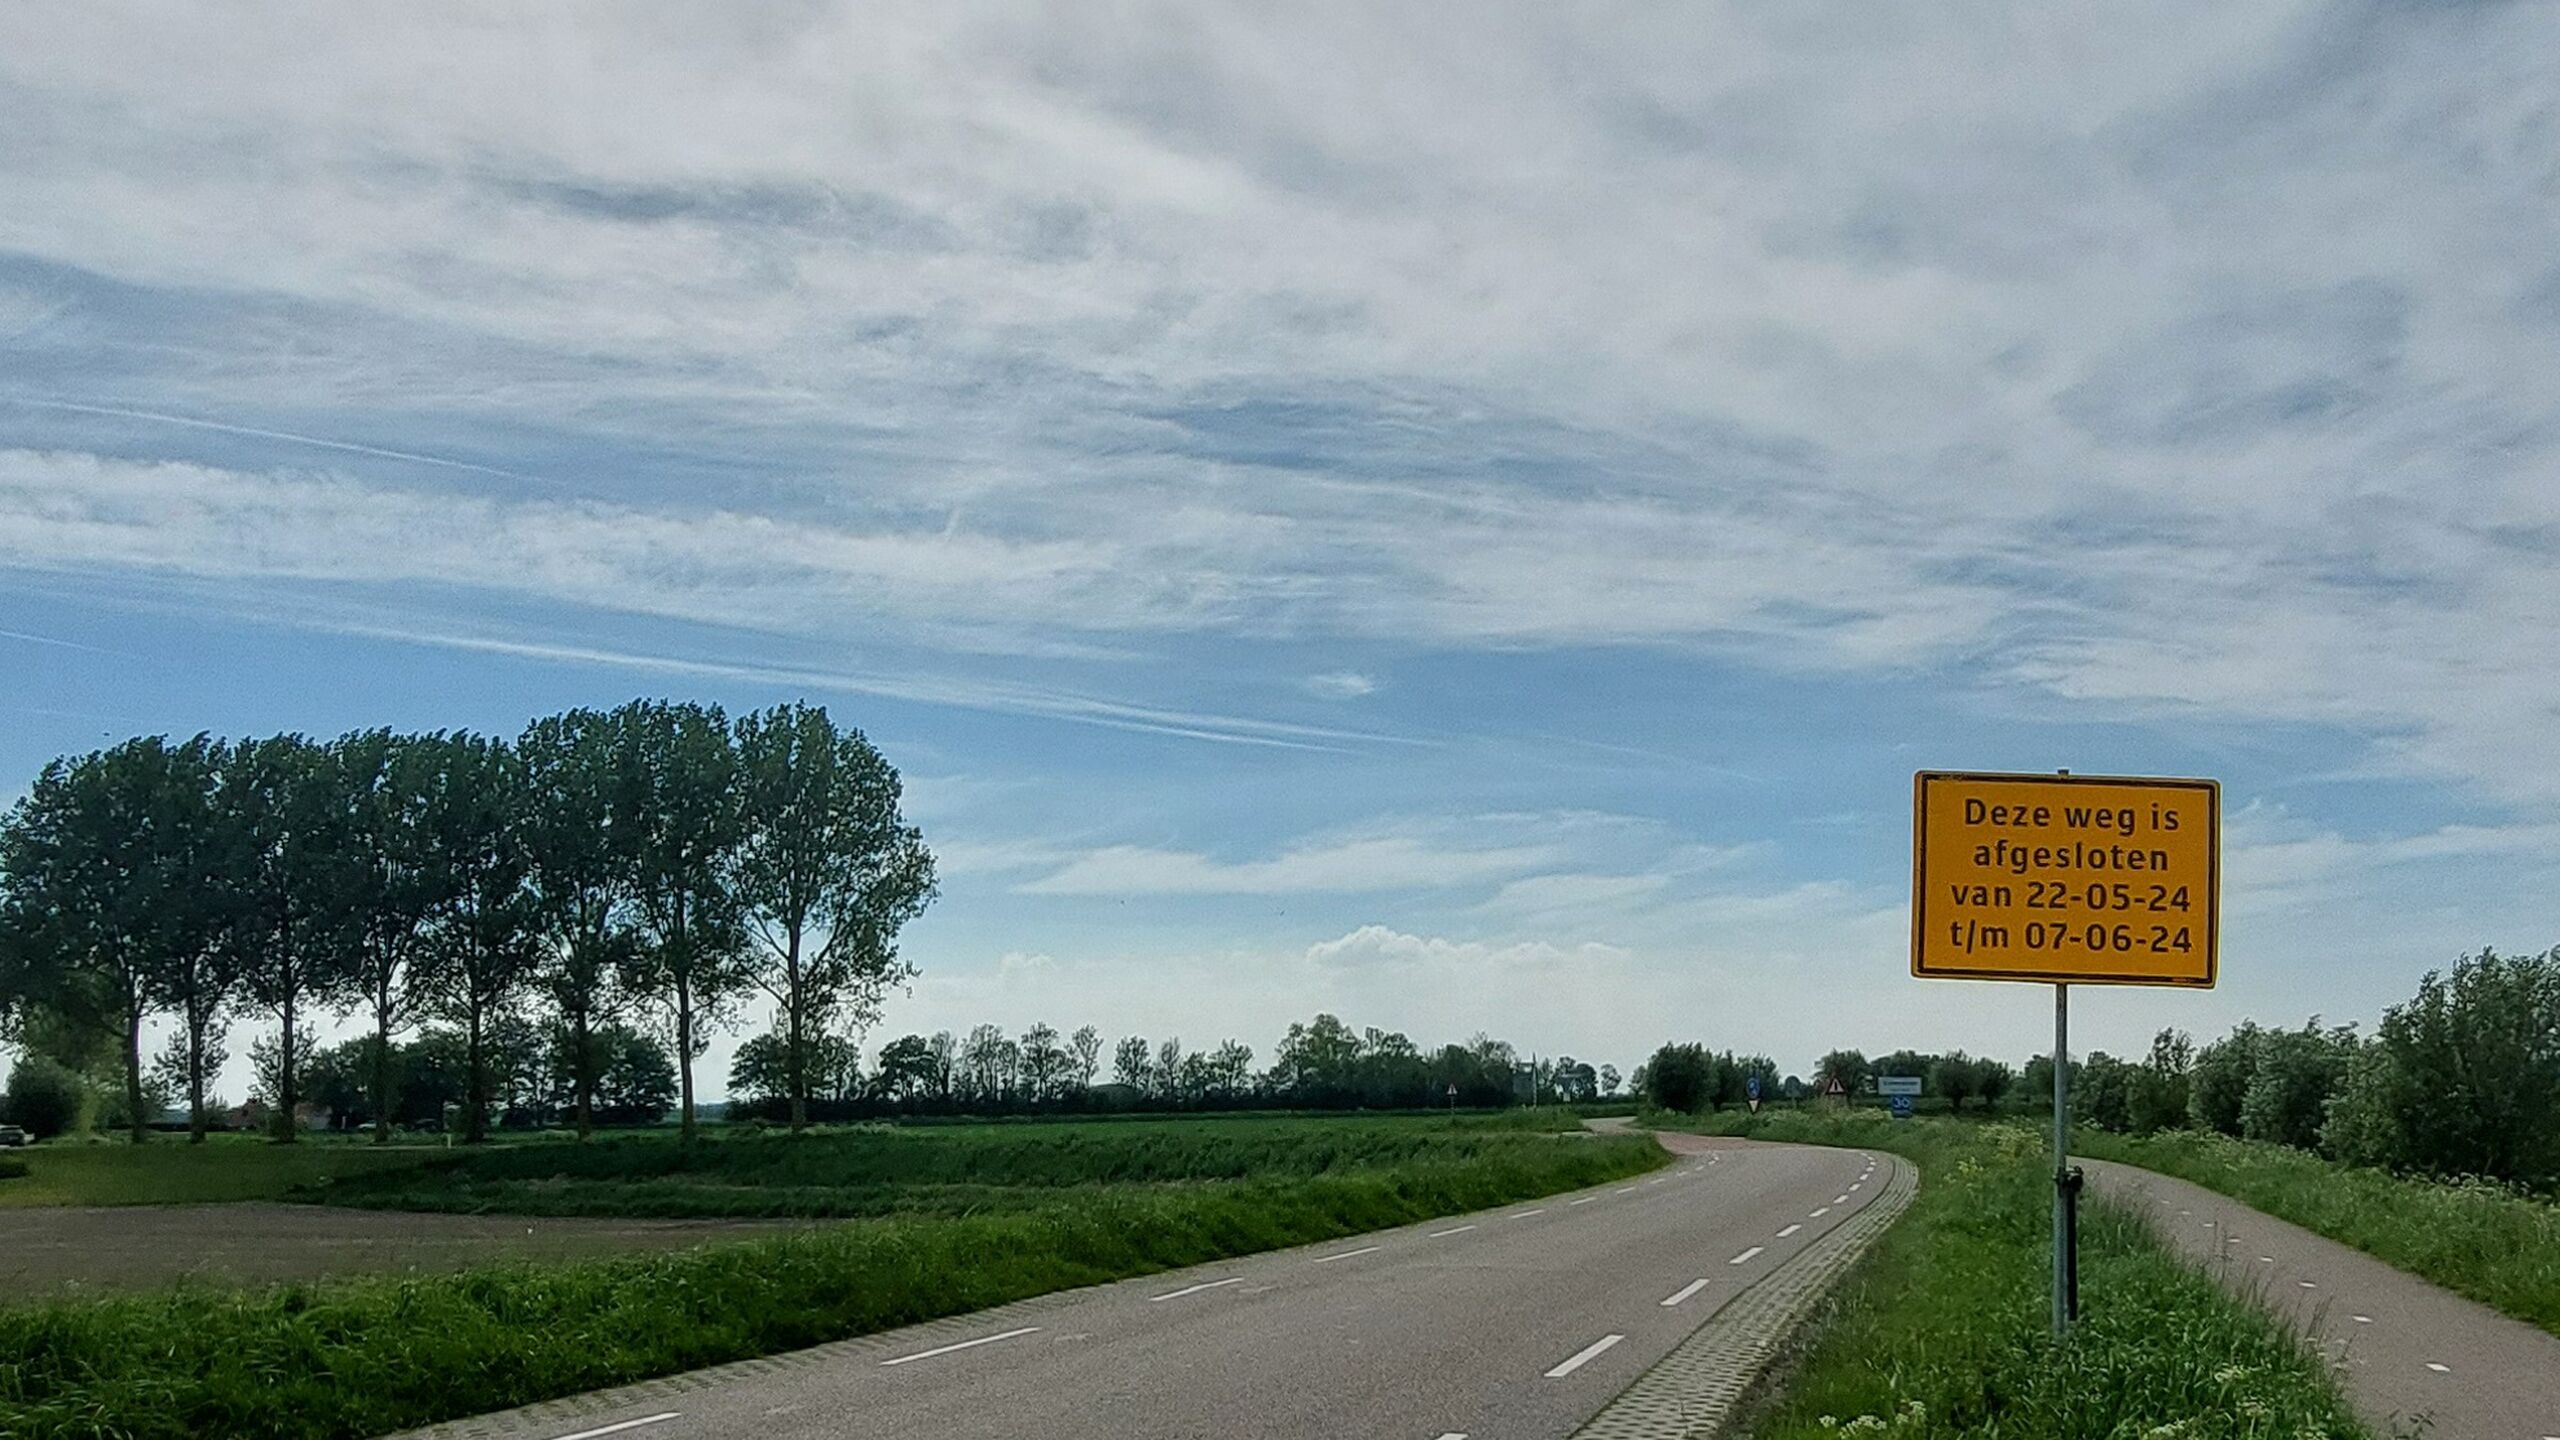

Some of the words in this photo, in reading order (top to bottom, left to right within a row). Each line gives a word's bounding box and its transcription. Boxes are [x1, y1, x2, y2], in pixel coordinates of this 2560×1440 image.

[1964, 798, 2051, 827] Deze
[2064, 804, 2136, 837] weg
[2151, 802, 2180, 832] is
[1973, 839, 2169, 875] afgesloten
[1951, 884, 2012, 907] van
[2026, 881, 2191, 912] 22-05-24
[1950, 919, 2009, 954] t/m
[2025, 922, 2192, 953] 07-06-24
